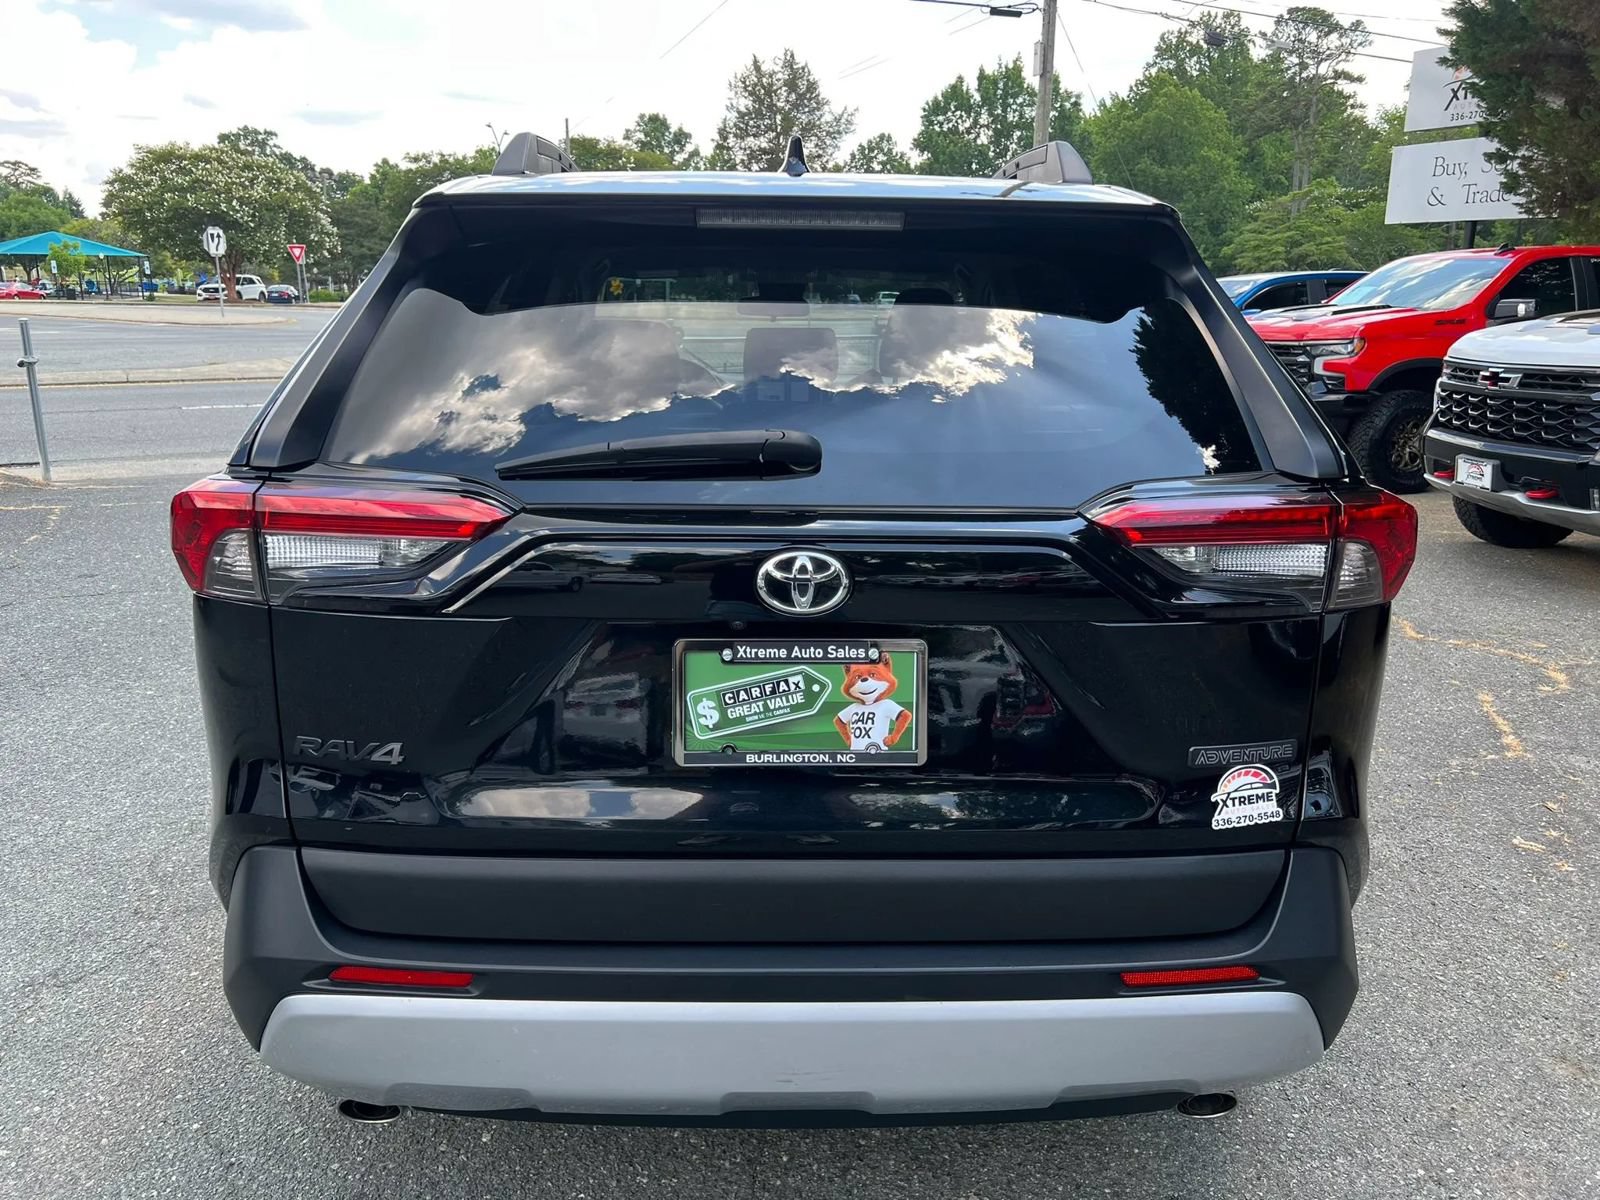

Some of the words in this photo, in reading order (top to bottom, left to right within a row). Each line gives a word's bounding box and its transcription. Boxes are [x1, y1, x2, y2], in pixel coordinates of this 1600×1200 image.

[1432, 156, 1468, 180] Buy,
[1427, 186, 1447, 206] &
[736, 645, 787, 659] Xtreme
[791, 645, 823, 659] Auto
[827, 645, 866, 659] Sales
[723, 679, 804, 705] CARFAX
[727, 701, 765, 719] GREAT
[767, 692, 805, 710] VALUE
[293, 735, 405, 765] RAV4
[746, 753, 833, 765] BURLINGTON,
[836, 753, 856, 764] NC
[1195, 744, 1293, 765] ADVENTURE
[1217, 791, 1274, 816] XTREME
[1213, 809, 1281, 828] 336-270-5548
